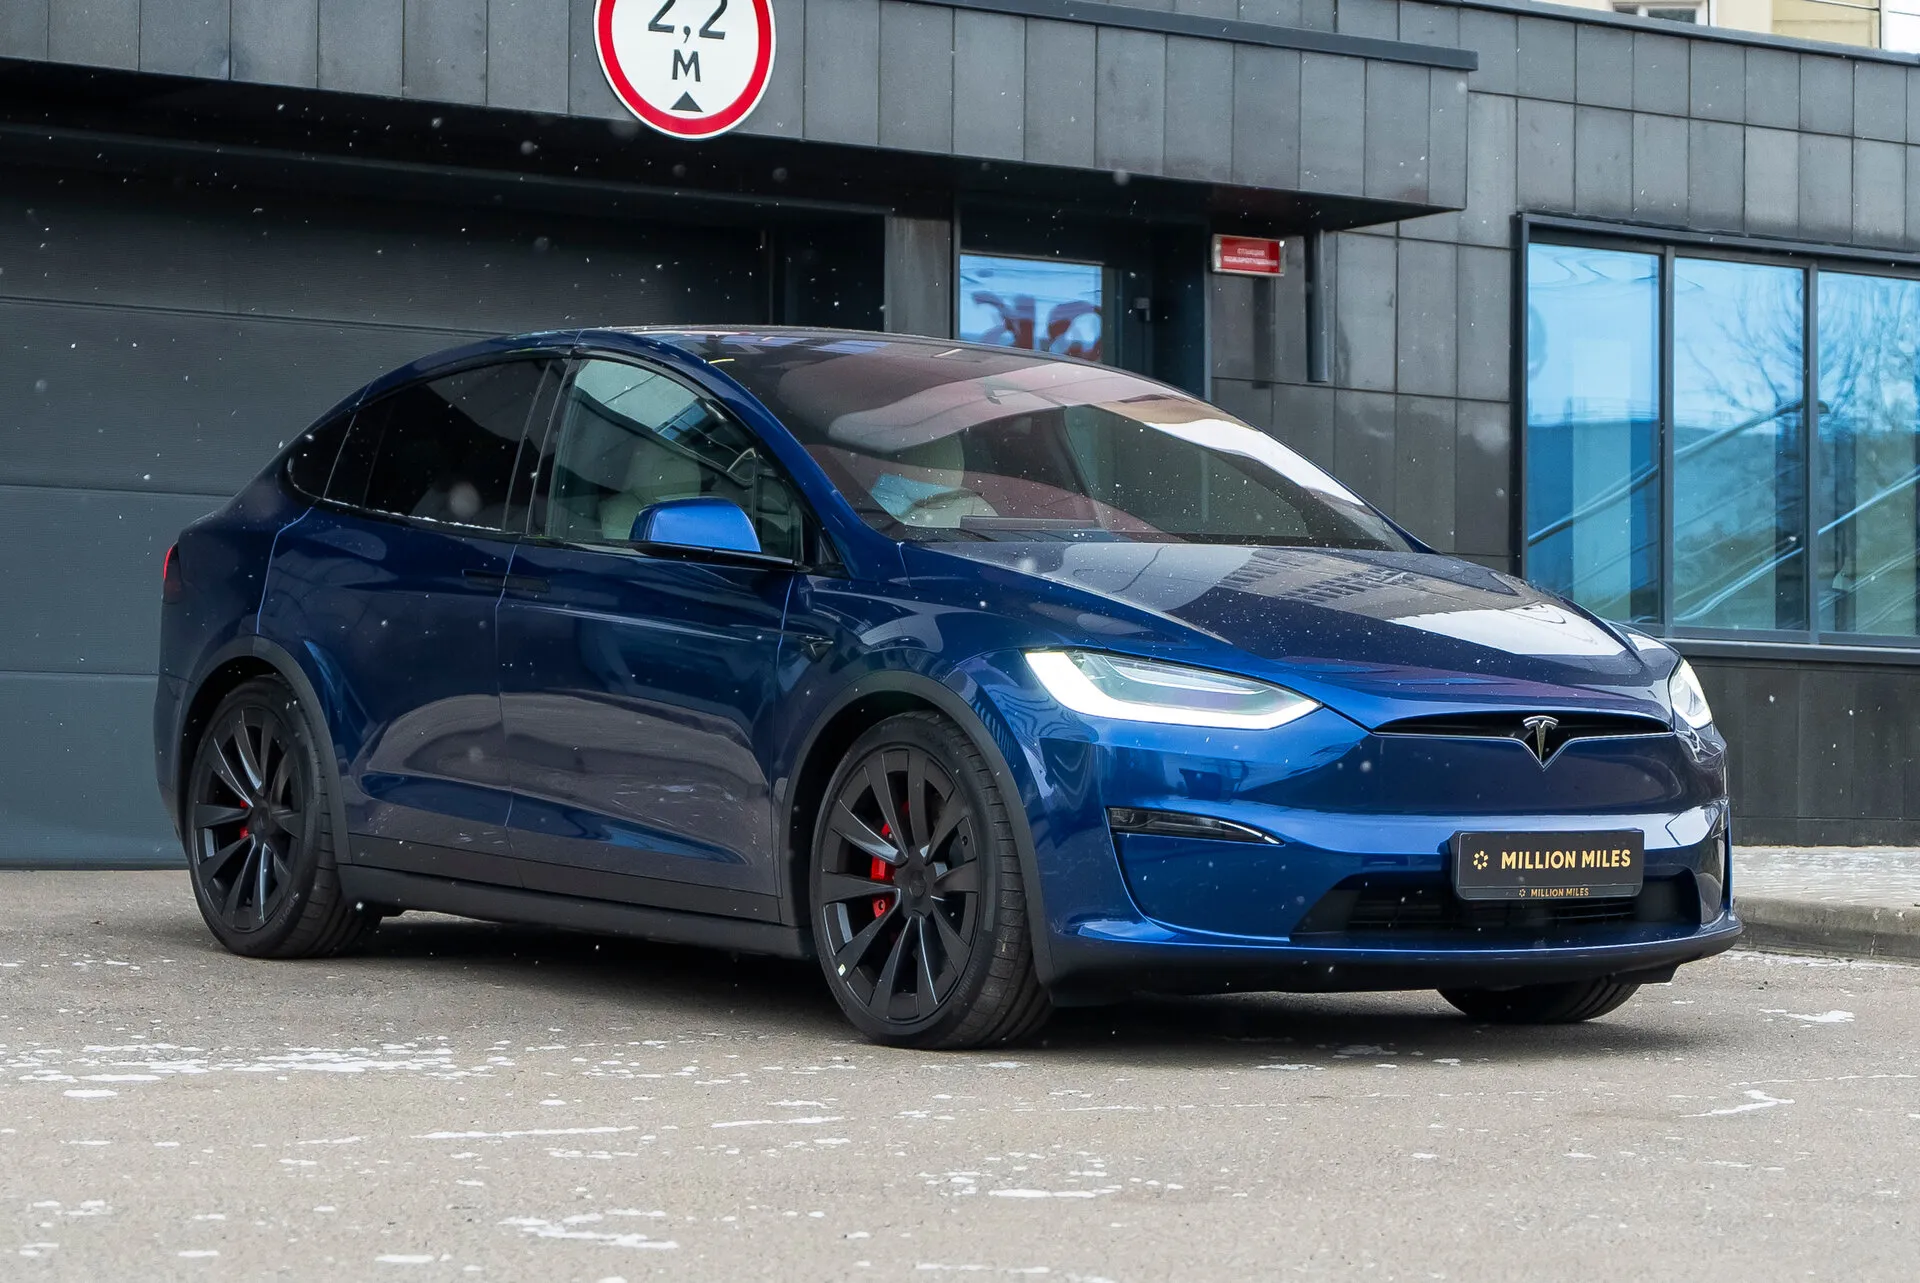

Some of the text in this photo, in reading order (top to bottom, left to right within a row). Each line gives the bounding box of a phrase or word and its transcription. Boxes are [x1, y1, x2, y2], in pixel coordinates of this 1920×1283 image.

[648, 0, 727, 43] 2,2
[1501, 849, 1631, 869] MILLION MILES
[1530, 887, 1589, 897] MILLION MILES
